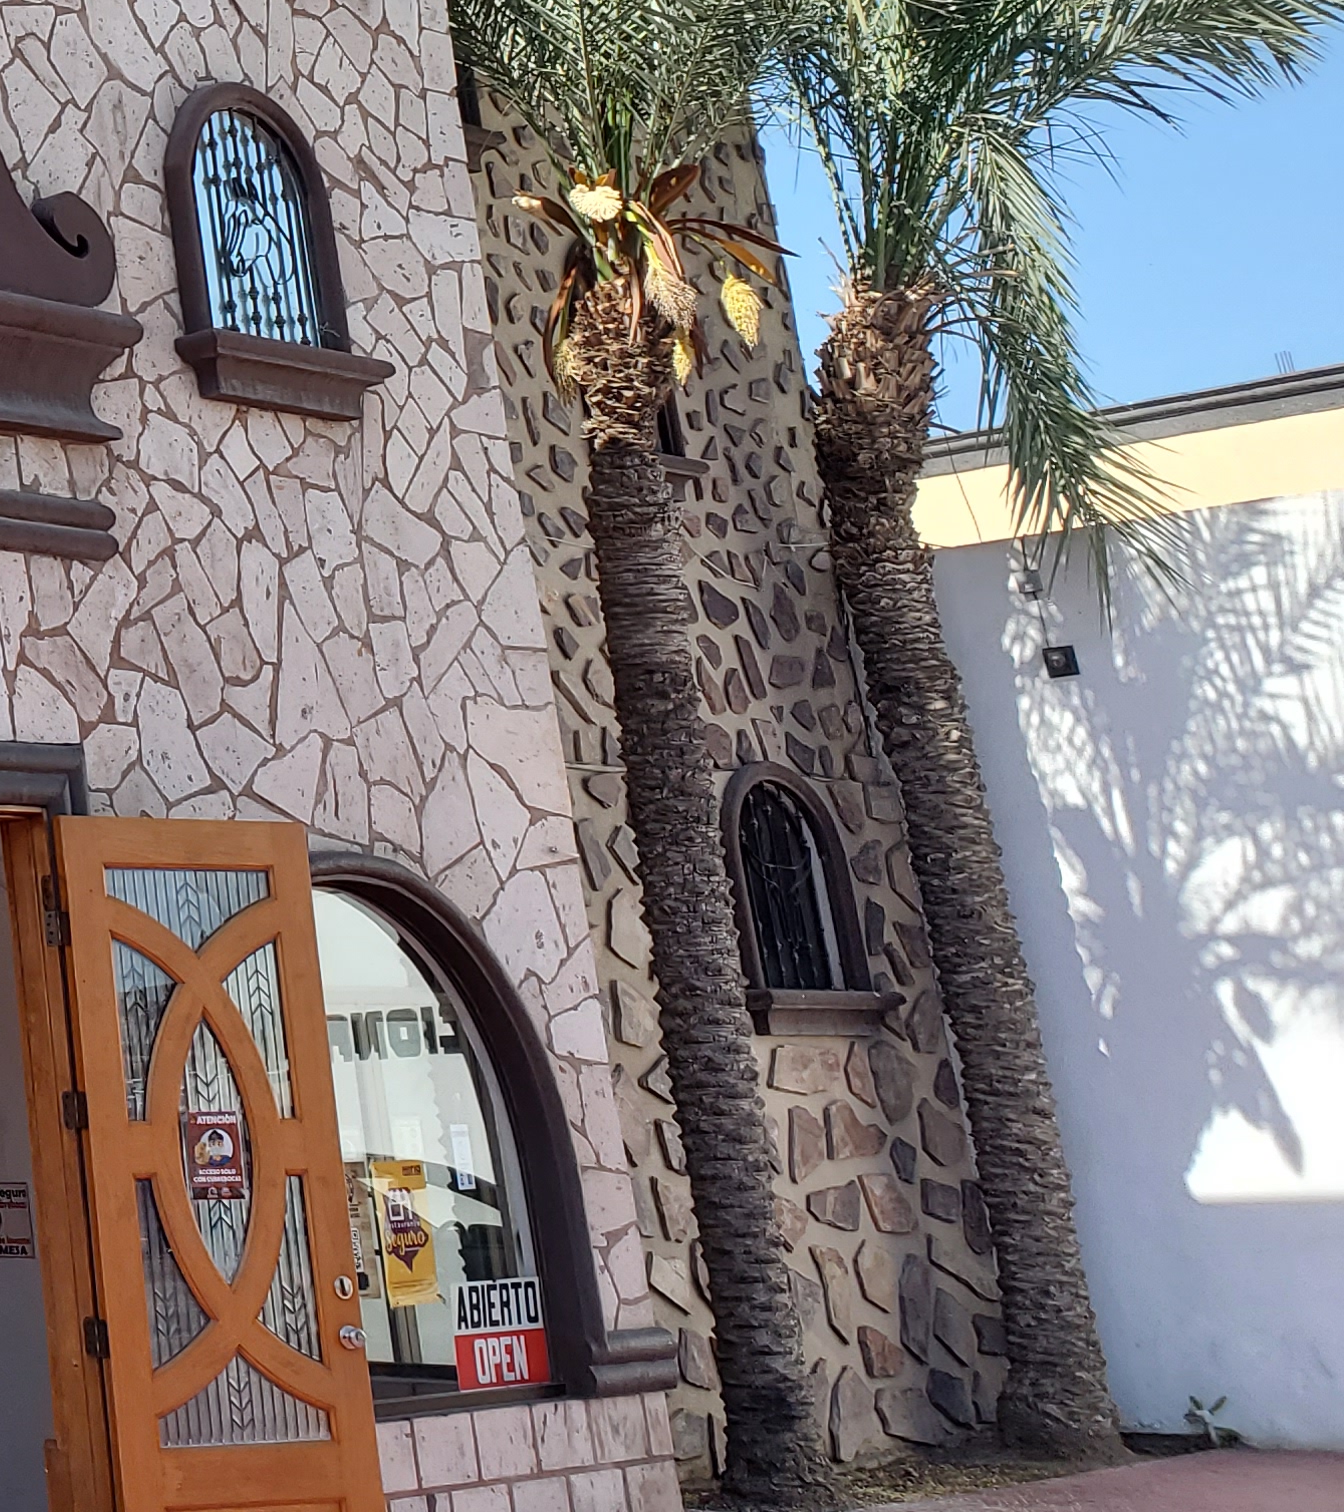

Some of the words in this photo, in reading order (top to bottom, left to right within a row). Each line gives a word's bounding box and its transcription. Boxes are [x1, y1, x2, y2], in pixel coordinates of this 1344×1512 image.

[196, 1113, 237, 1125] ATENCIÓN
[0, 1245, 29, 1256] MESA
[457, 1280, 540, 1330] ABIERTO
[473, 1334, 530, 1385] OPEN
